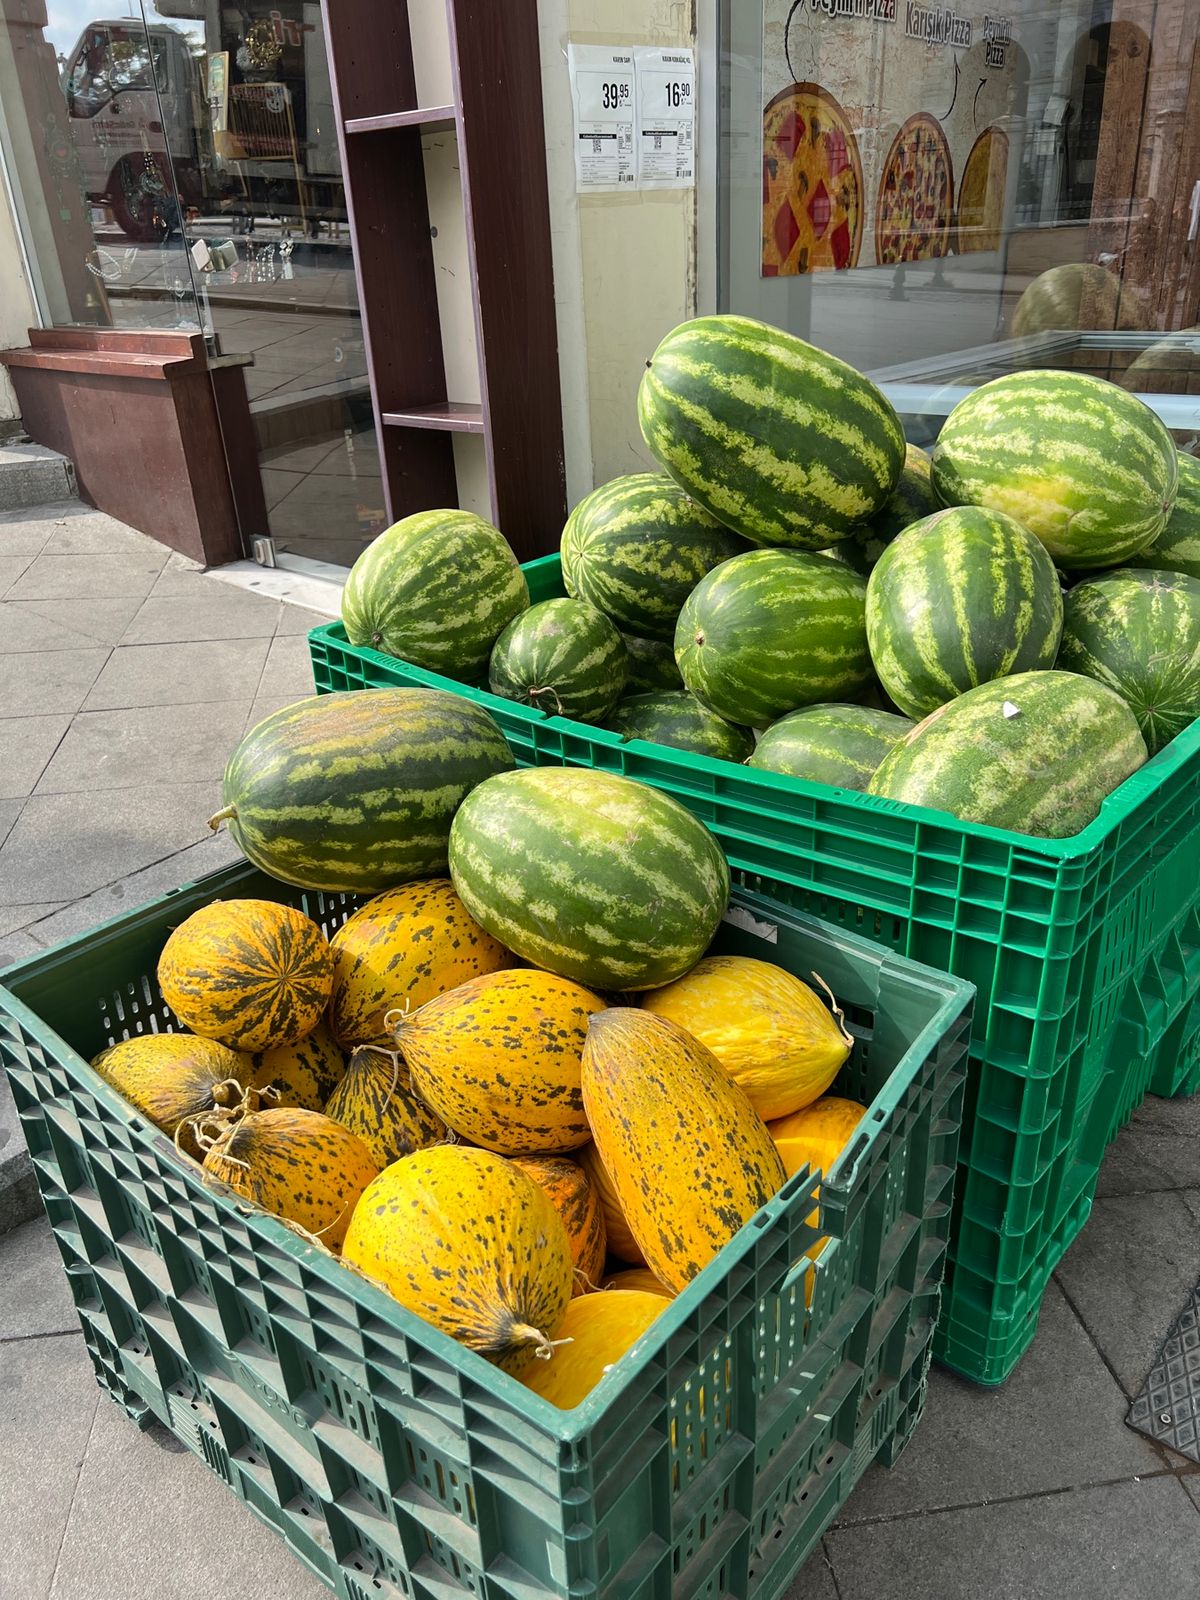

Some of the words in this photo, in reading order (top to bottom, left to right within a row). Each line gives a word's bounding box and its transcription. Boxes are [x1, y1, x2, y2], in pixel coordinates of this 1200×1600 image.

[905, 1, 943, 45] Karışık
[943, 9, 972, 46] Pizza
[986, 41, 1004, 66] Pizza
